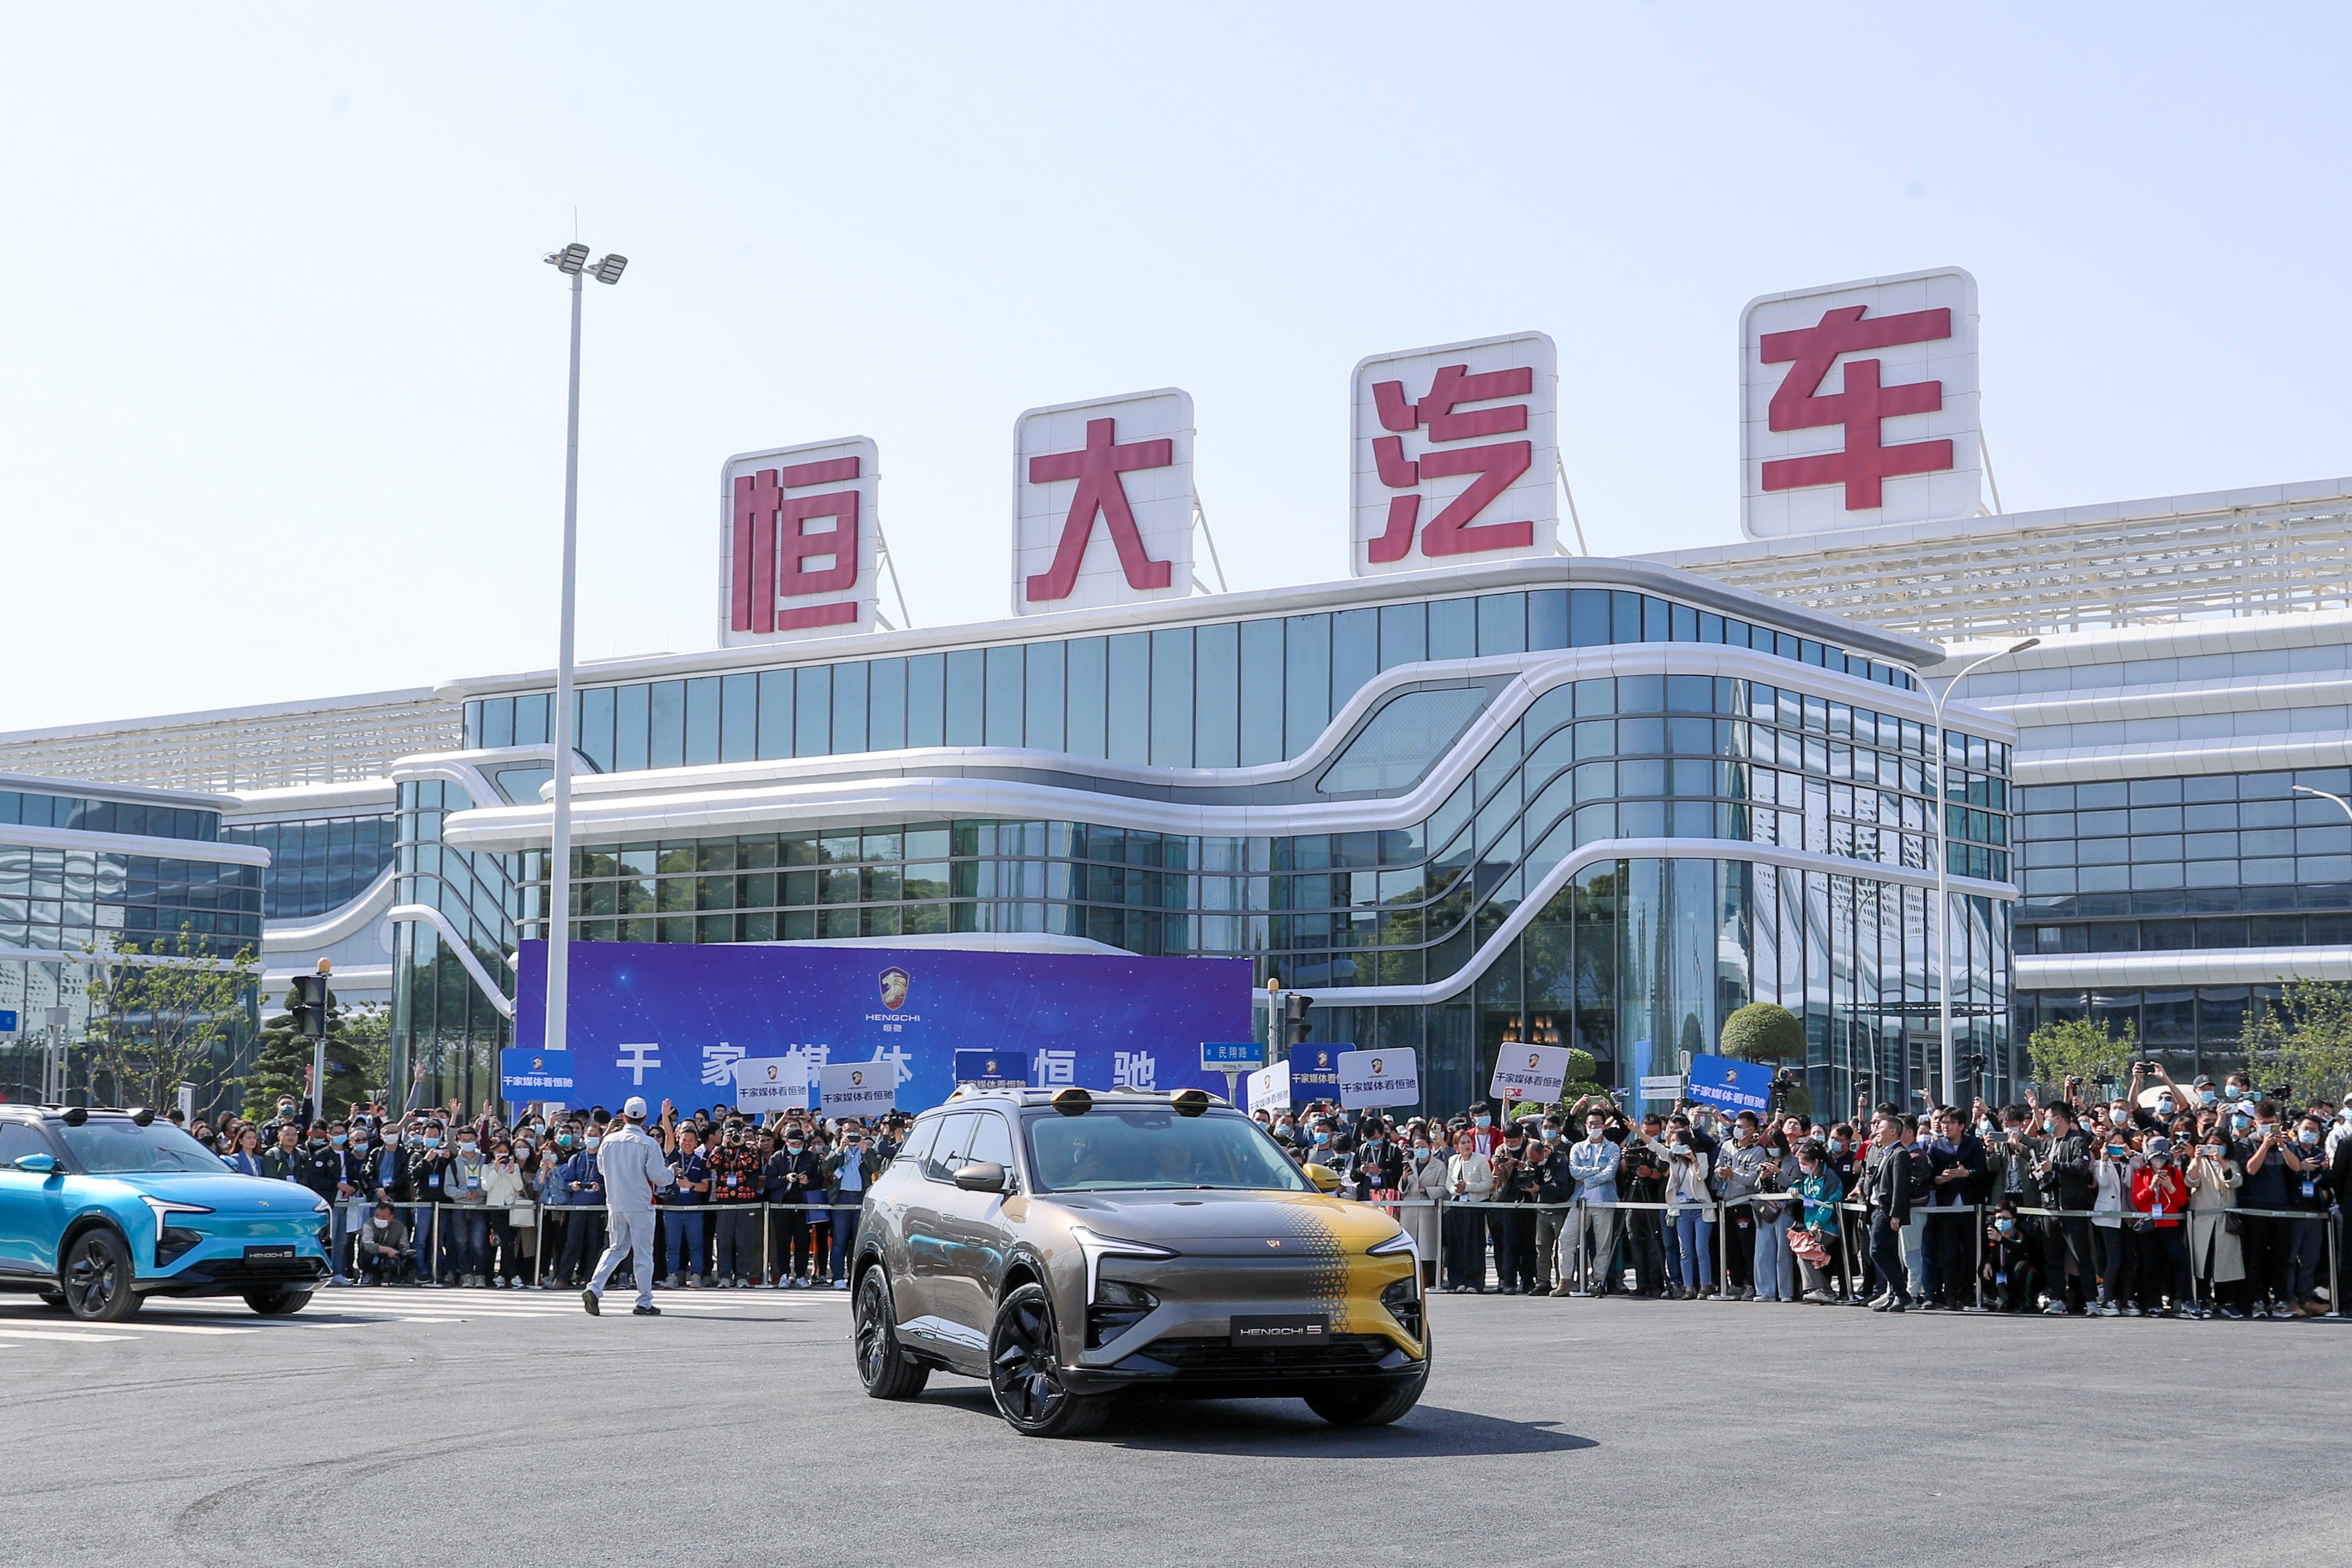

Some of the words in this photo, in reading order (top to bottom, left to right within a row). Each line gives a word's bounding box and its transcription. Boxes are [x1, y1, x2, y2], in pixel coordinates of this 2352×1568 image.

[1219, 1047, 1247, 1058] 民翔路
[503, 1076, 573, 1088] 千家媒体看恒驰
[1342, 1078, 1416, 1093] 千家媒体看恒驰
[1496, 1072, 1561, 1088] 千家媒体看恒驰
[739, 1085, 807, 1098] 千家媒体看恒驰
[822, 1090, 894, 1104] 千家媒体看恒驰
[1690, 1083, 1765, 1109] 千家媒体看恒驰
[1307, 1325, 1322, 1335] 5
